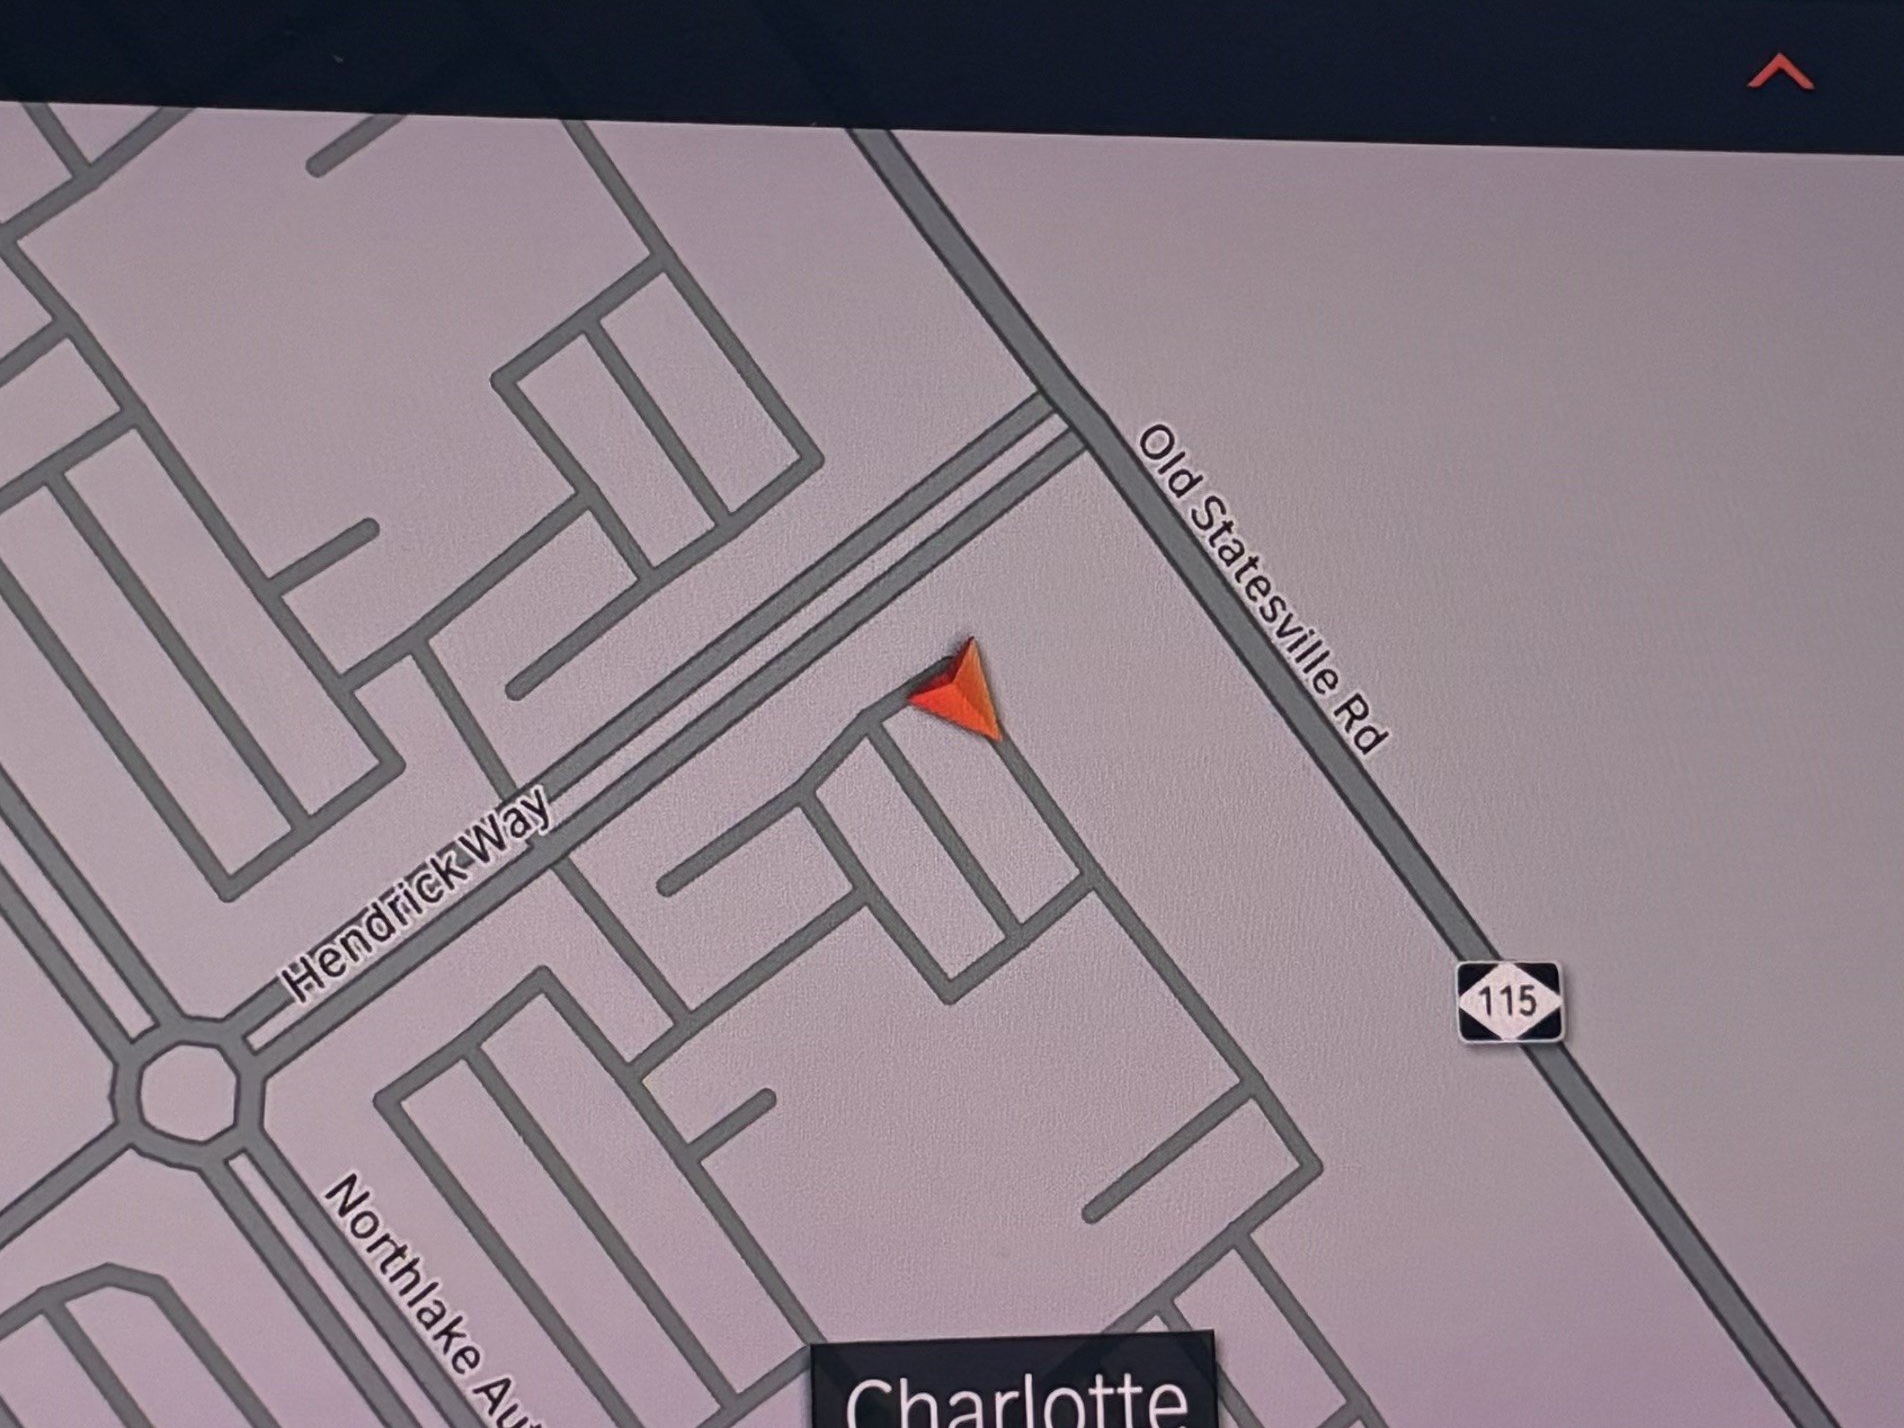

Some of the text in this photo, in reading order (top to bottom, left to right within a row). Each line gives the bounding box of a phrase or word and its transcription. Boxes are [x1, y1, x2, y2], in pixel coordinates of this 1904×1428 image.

[1139, 423, 1390, 756] Old Statesville Rd
[281, 788, 550, 1003] Hendrick Way
[1477, 984, 1538, 1019] 115
[324, 1172, 481, 1375] Northlake
